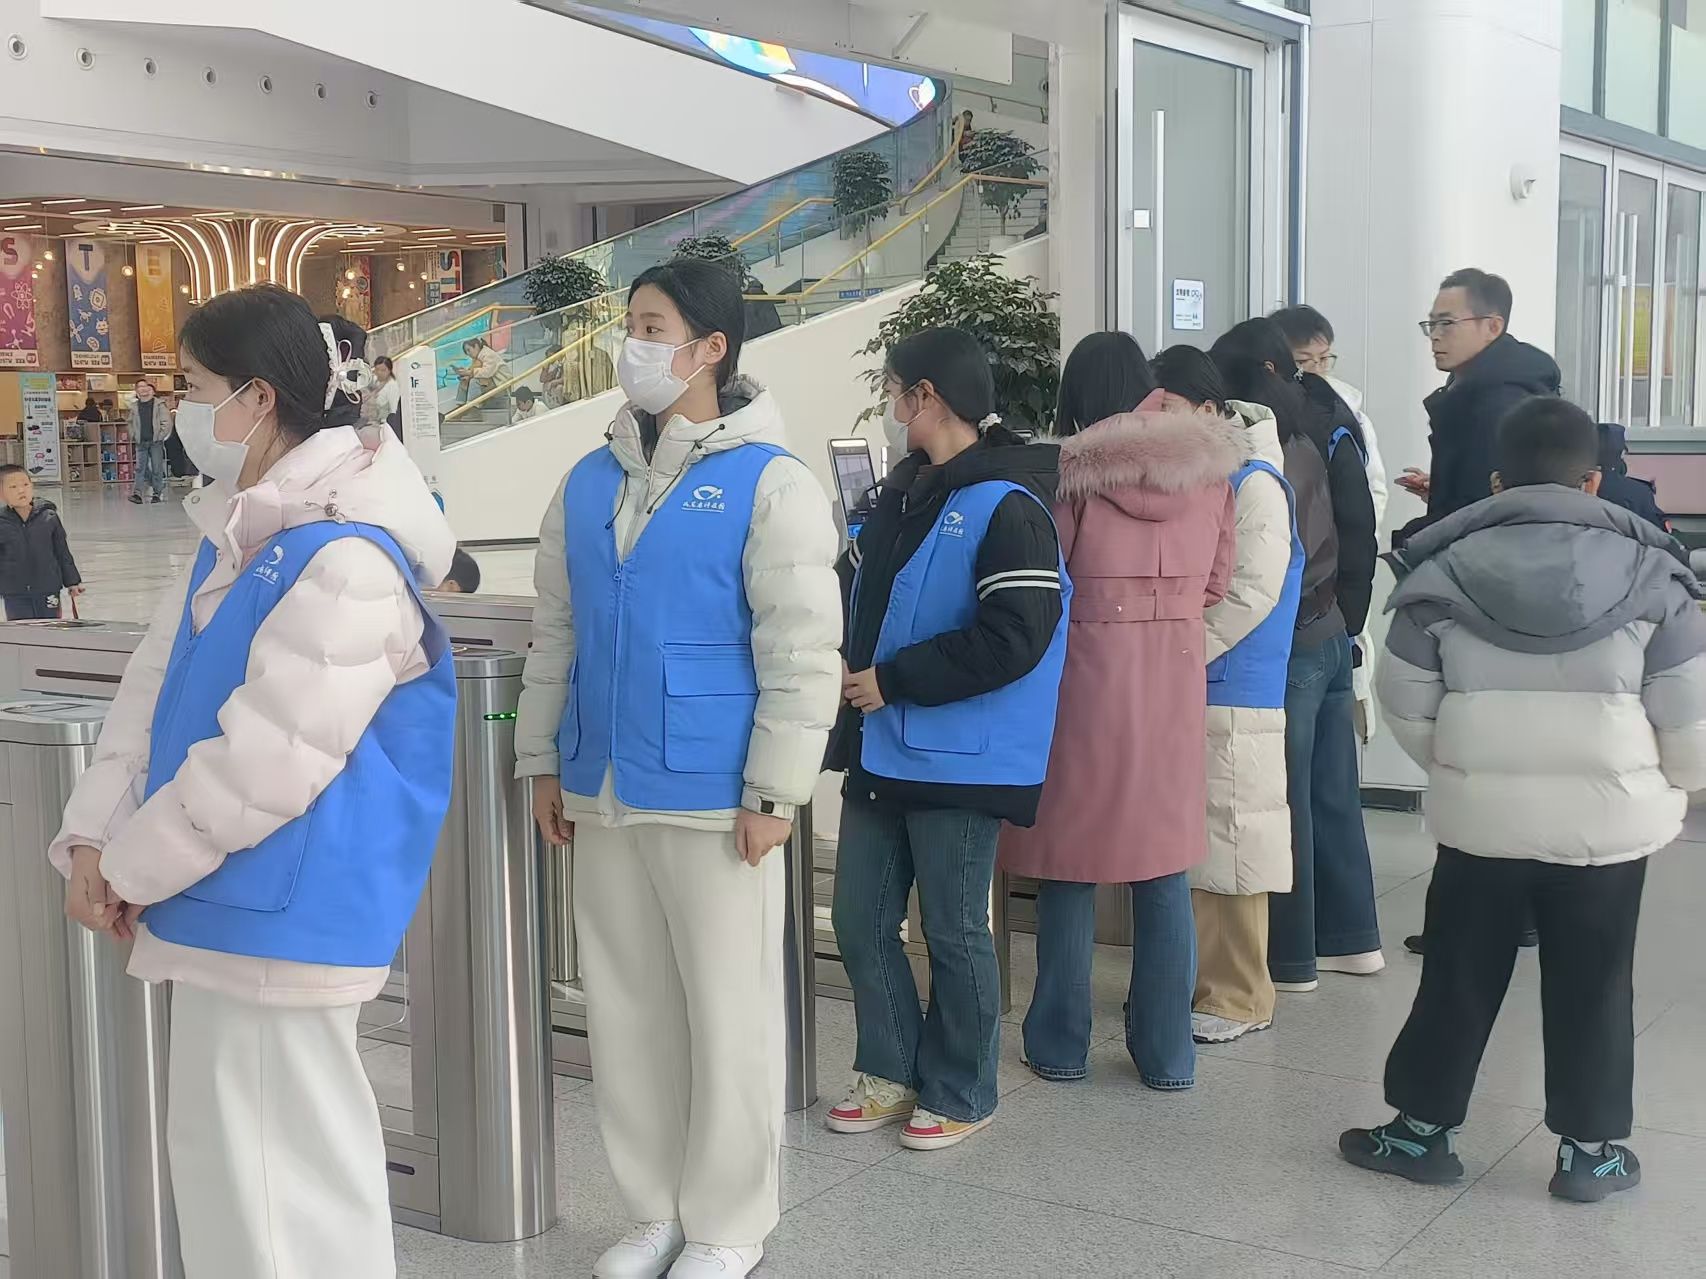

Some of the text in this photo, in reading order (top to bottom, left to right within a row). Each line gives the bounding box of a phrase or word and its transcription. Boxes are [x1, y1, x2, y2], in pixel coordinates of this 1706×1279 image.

[1, 237, 19, 266] S
[78, 244, 94, 271] T
[410, 376, 420, 388] 1F
